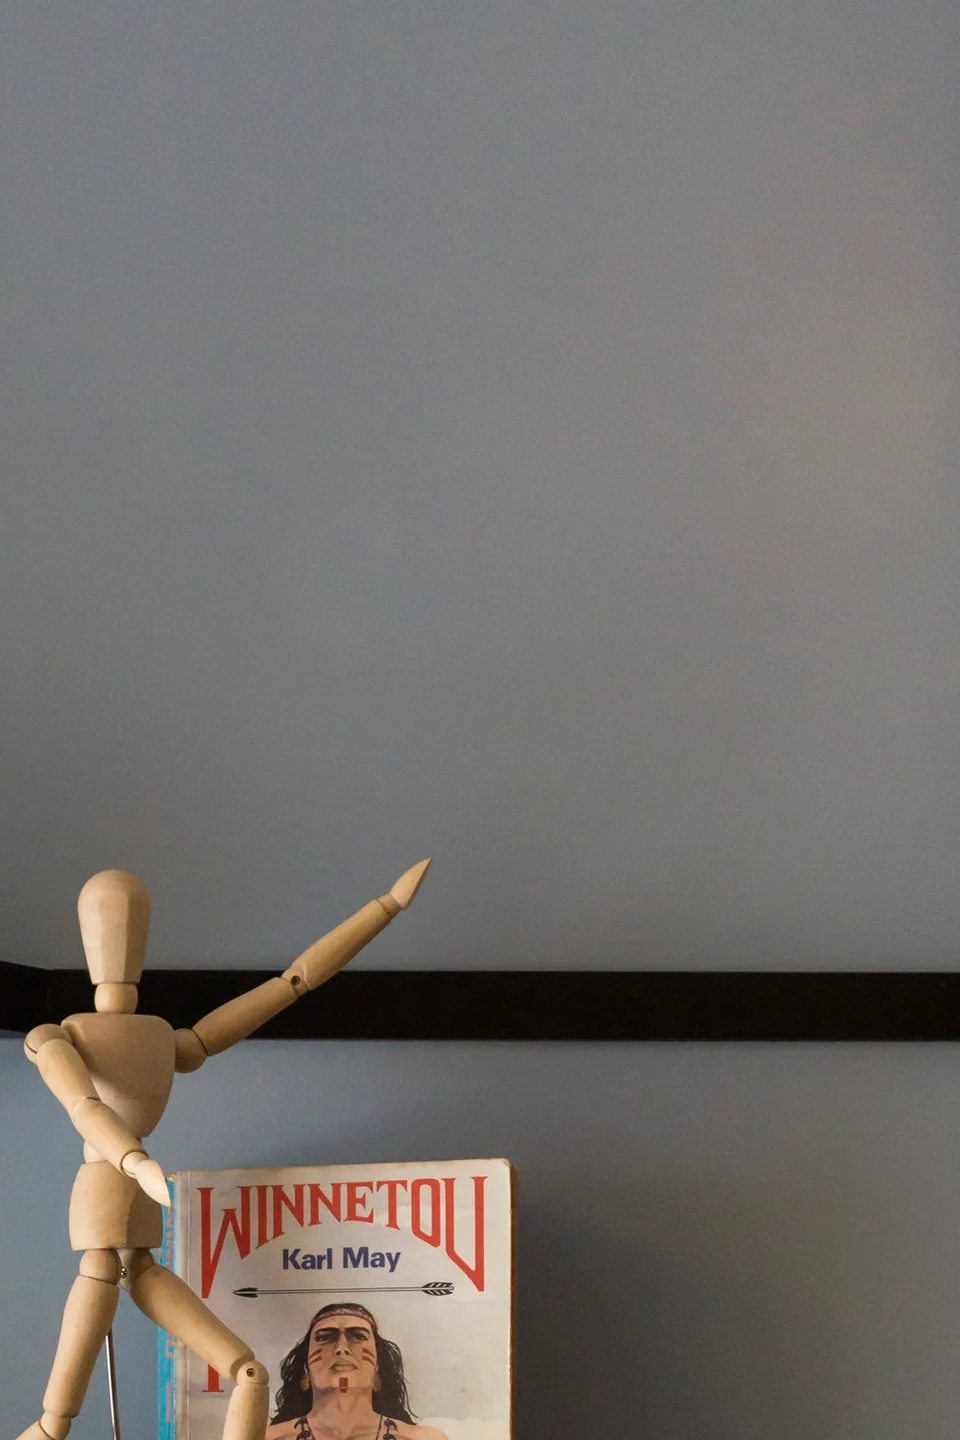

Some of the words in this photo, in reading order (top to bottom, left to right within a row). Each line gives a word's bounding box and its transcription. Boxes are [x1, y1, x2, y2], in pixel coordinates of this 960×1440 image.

[196, 1176, 489, 1299] WINNETOU
[282, 1247, 333, 1270] Karl
[342, 1246, 402, 1272] May
